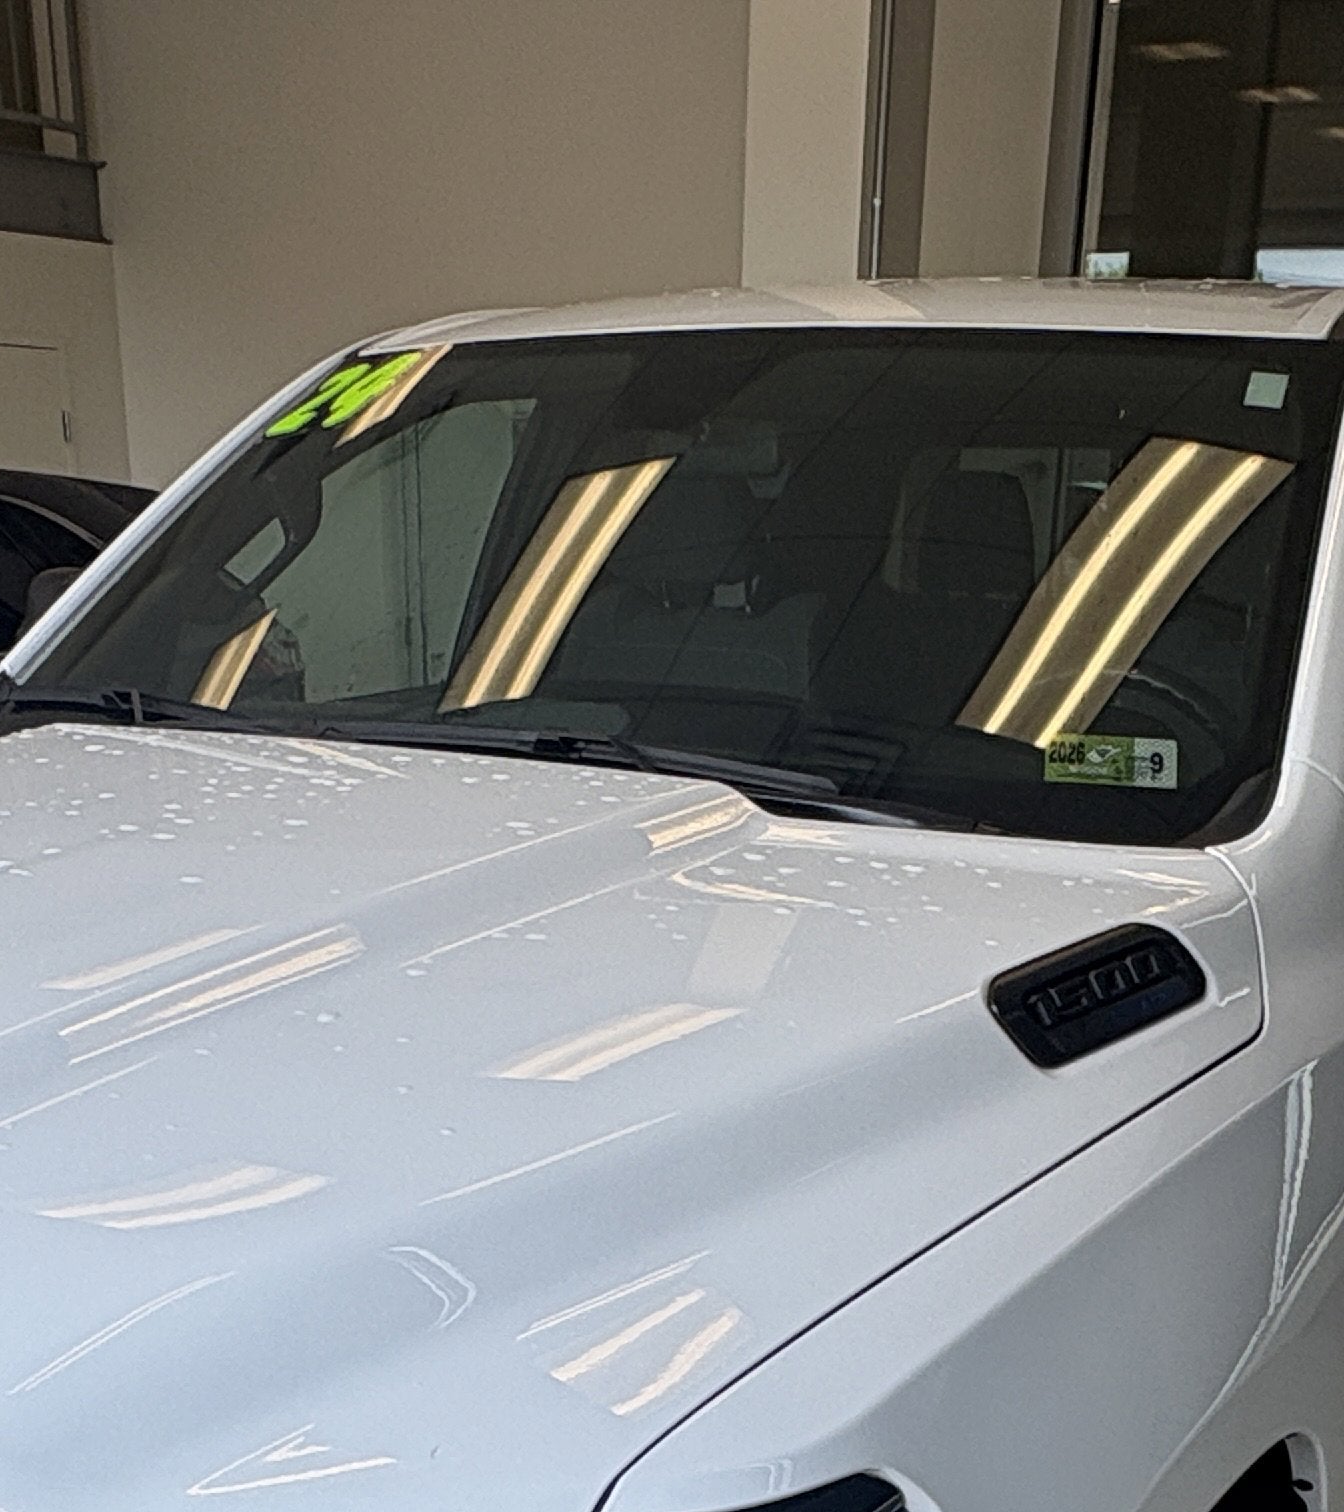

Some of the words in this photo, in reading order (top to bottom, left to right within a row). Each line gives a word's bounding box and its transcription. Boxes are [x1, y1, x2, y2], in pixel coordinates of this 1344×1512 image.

[1048, 740, 1086, 764] 2026
[1149, 752, 1164, 774] 9
[1026, 952, 1162, 1027] 1500
